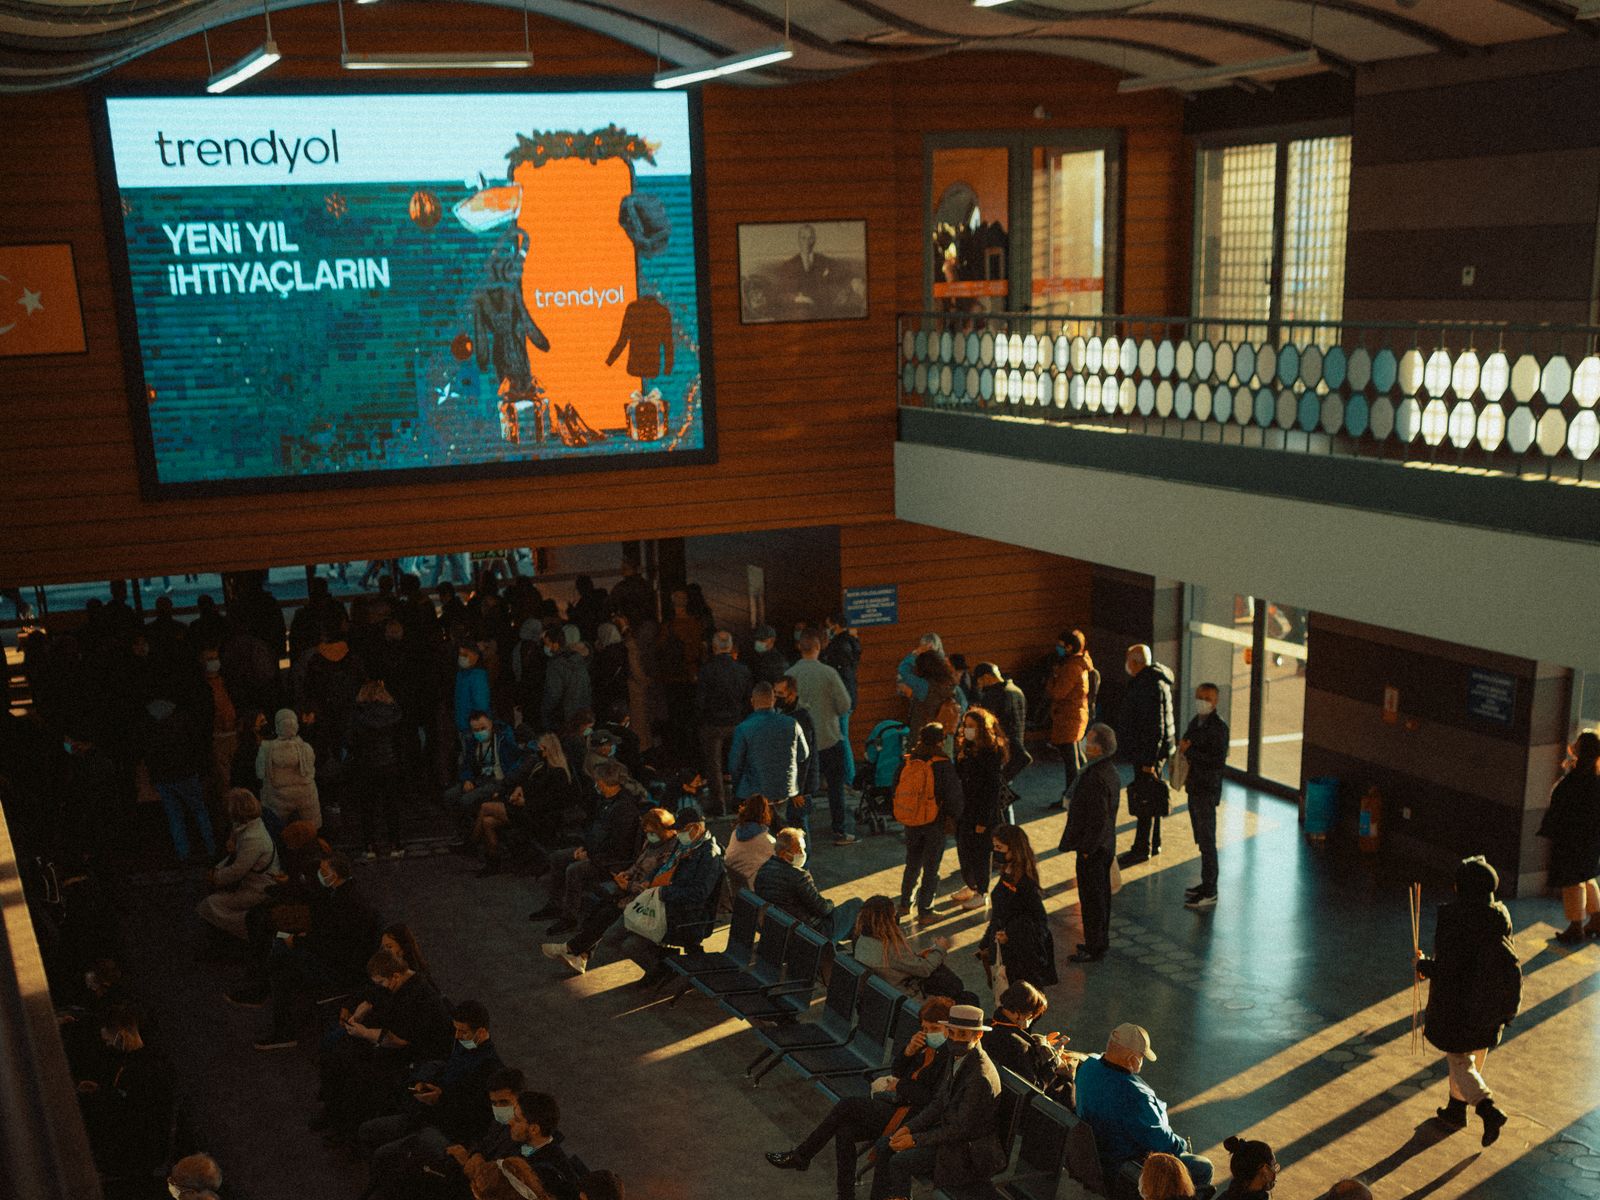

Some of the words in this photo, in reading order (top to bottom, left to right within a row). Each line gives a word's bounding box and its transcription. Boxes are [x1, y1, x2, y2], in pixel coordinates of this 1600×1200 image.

[156, 129, 339, 173] trendyol
[163, 224, 242, 255] YENİ
[245, 221, 299, 253] YIL
[535, 285, 624, 308] trendyol
